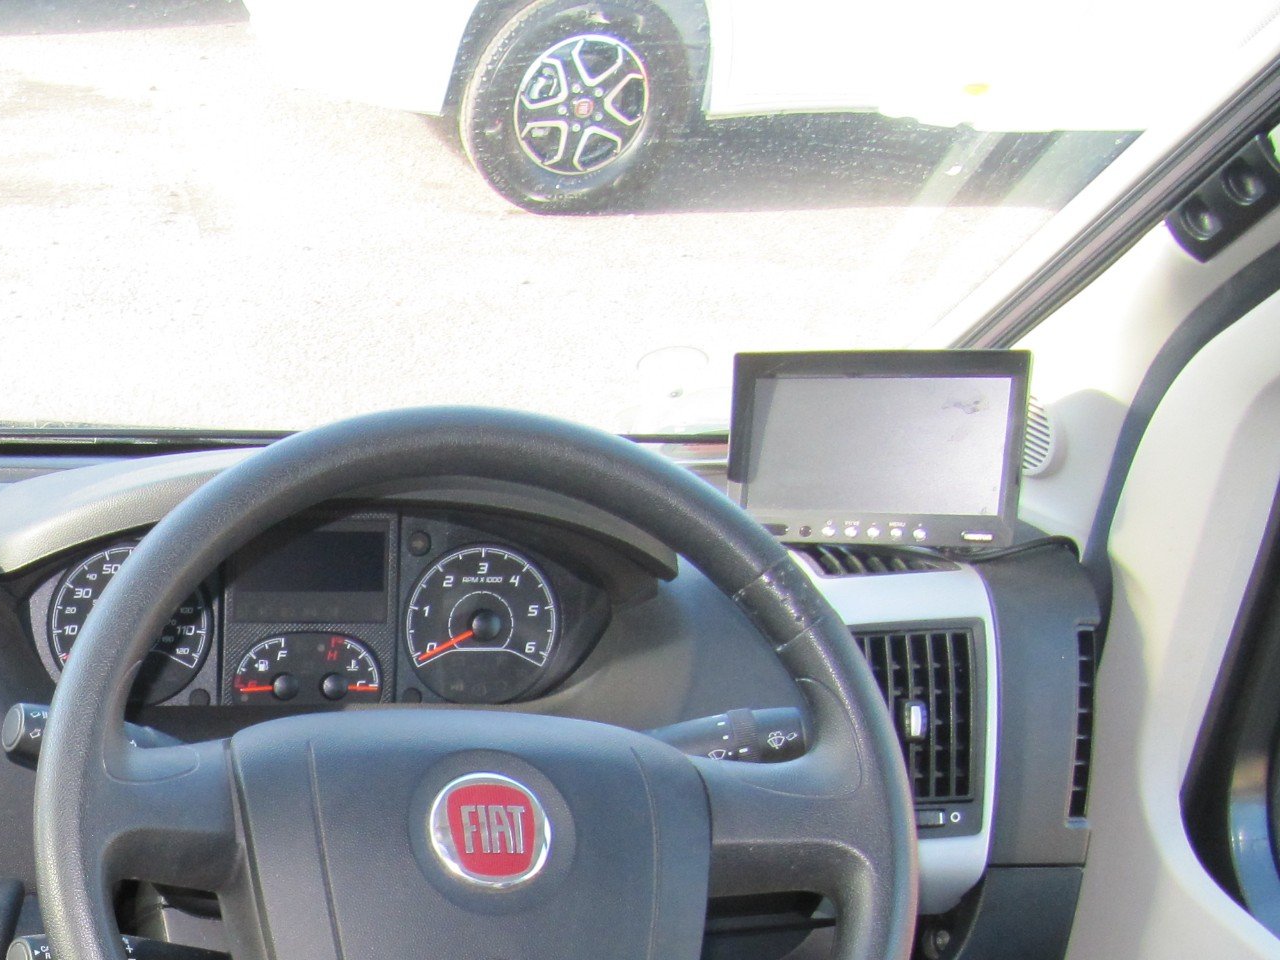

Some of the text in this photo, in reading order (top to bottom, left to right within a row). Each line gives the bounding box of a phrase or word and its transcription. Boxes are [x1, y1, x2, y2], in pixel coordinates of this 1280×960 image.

[102, 564, 121, 575] 50
[477, 563, 489, 574] 3
[442, 575, 454, 587] 2
[509, 575, 520, 587] 4
[73, 588, 92, 599] 30
[422, 605, 430, 617] 1
[528, 605, 539, 617] 5
[63, 625, 78, 635] 10
[176, 624, 195, 636] 110
[176, 647, 190, 655] 120
[525, 642, 536, 653] 6
[277, 650, 287, 660] F
[327, 651, 338, 661] H
[460, 805, 525, 854] FIAT
